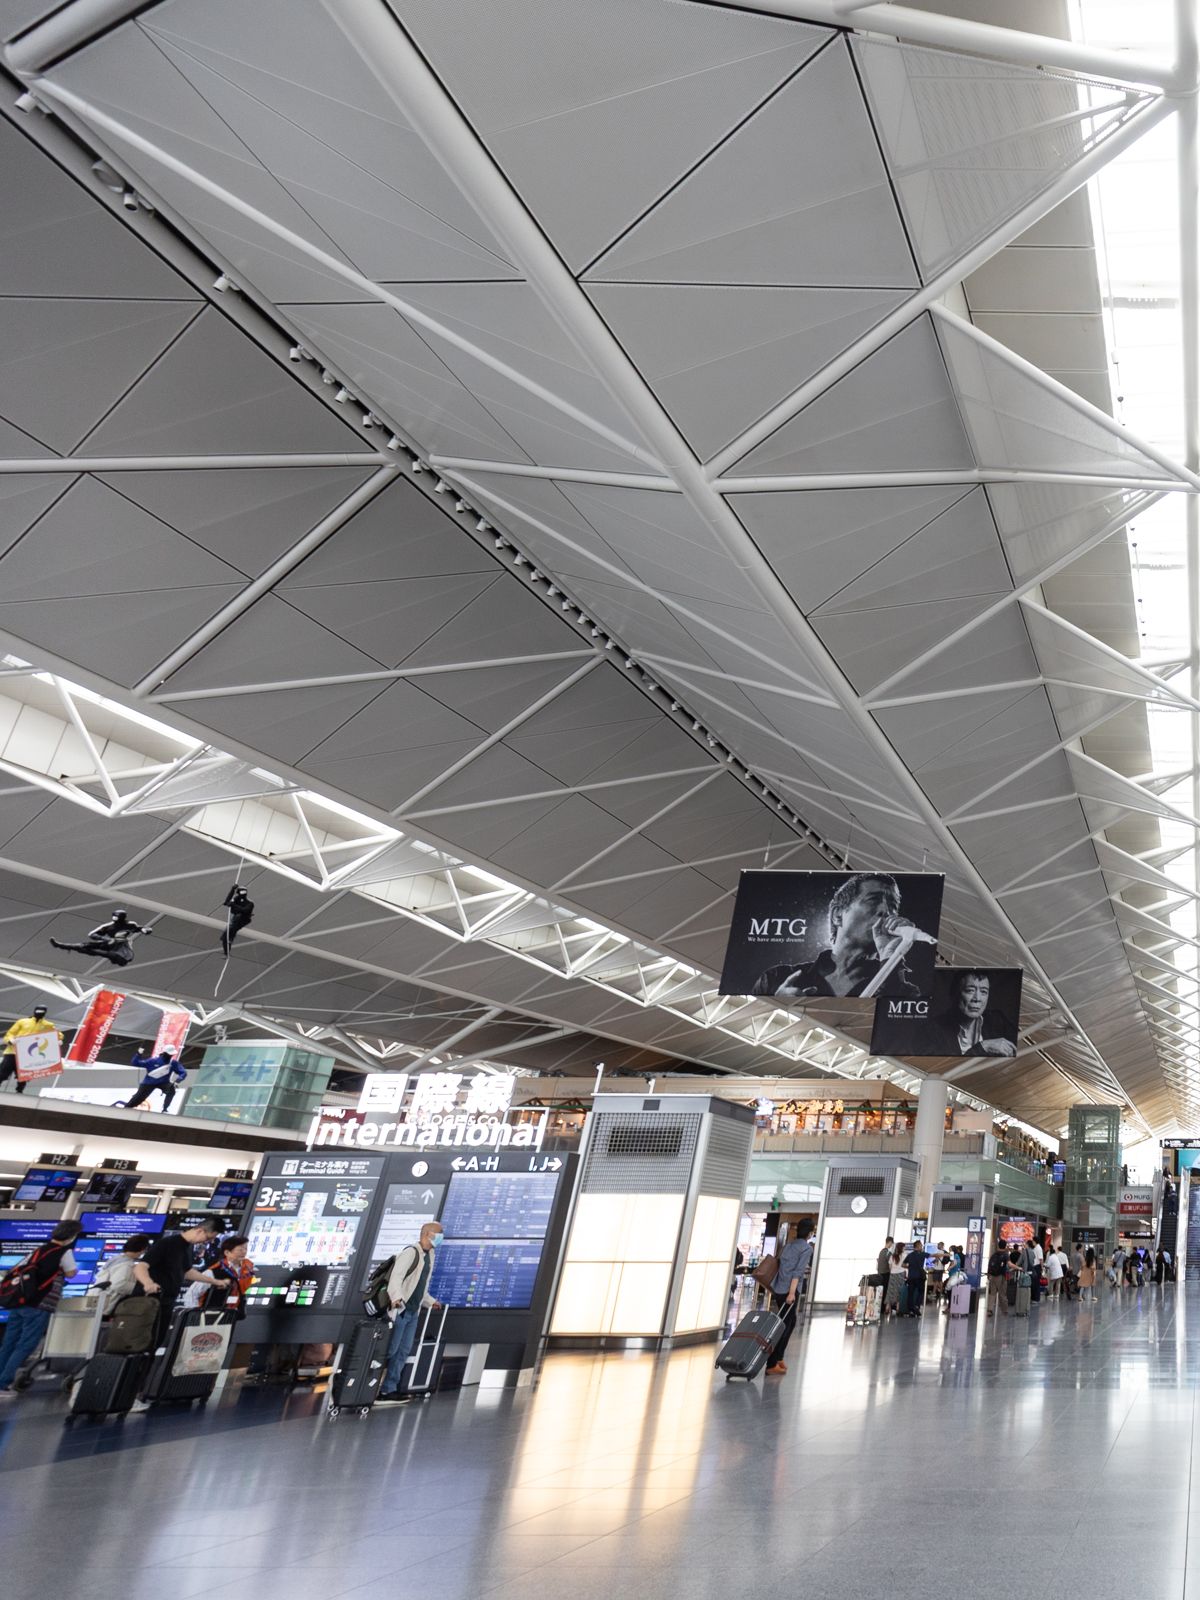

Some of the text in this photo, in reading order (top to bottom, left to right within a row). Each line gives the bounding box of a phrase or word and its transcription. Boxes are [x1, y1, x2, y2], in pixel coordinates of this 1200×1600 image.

[748, 917, 808, 936] MTG
[888, 1000, 929, 1014] MTG
[357, 1072, 516, 1113] 国際線
[306, 1112, 546, 1147] International
[52, 1155, 68, 1165] H2
[114, 1159, 129, 1169] H3
[465, 1156, 500, 1171] A-H
[234, 1169, 247, 1179] H4
[256, 1186, 283, 1206] 3F
